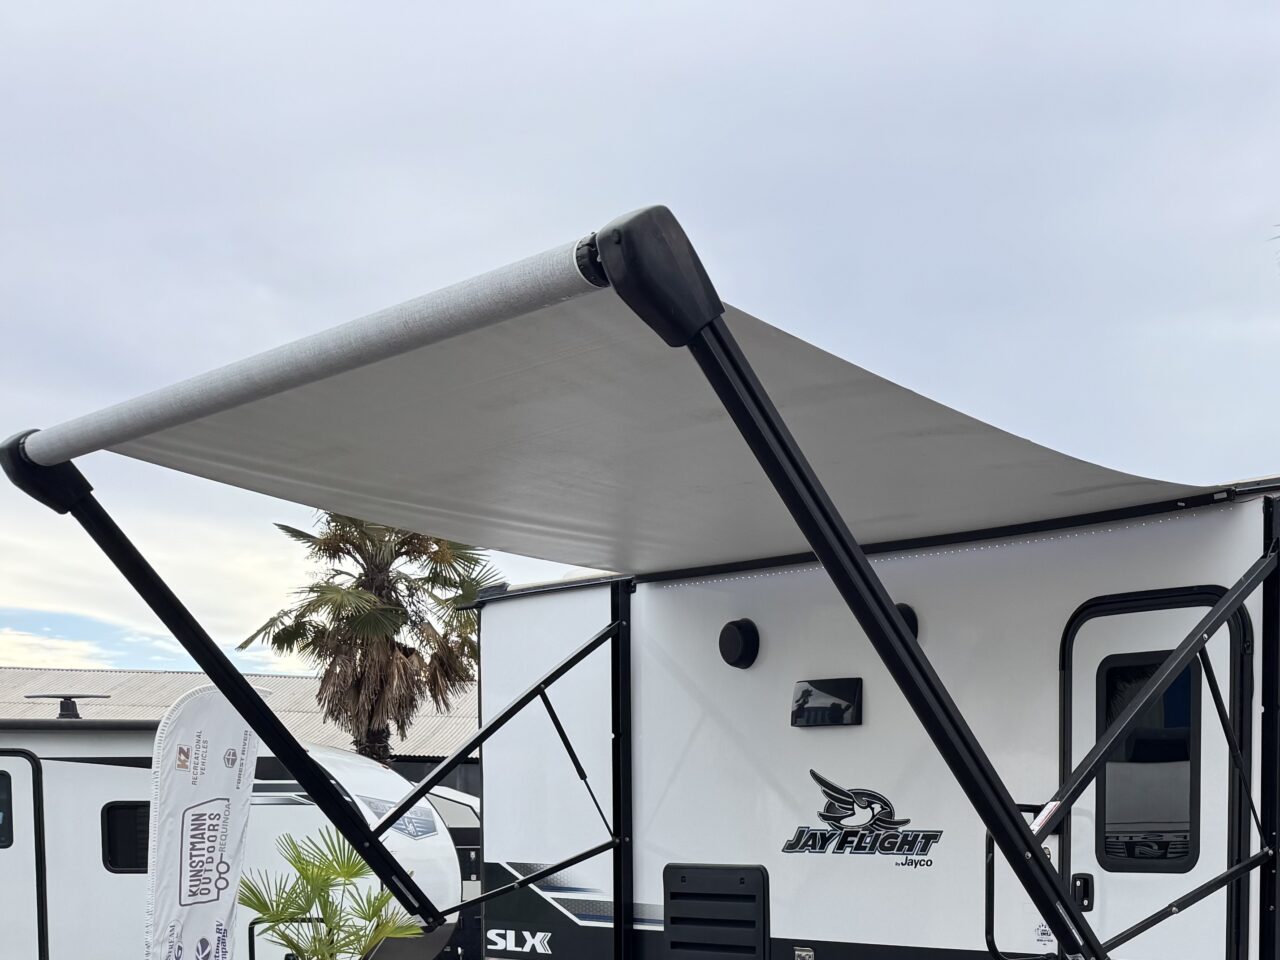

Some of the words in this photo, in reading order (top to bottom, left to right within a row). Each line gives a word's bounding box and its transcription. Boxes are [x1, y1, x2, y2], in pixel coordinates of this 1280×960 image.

[191, 730, 203, 786] RECREATIONAL
[199, 739, 209, 776] VEHICLES
[218, 802, 232, 853] REQUINOA
[782, 826, 840, 854] JAY
[832, 828, 944, 856] FLIGHT
[188, 812, 207, 898] KUNSTMANN
[199, 812, 221, 896] OUTDOORS
[901, 856, 933, 869] Jayco
[215, 920, 224, 935] RV
[486, 928, 553, 954] SLX
